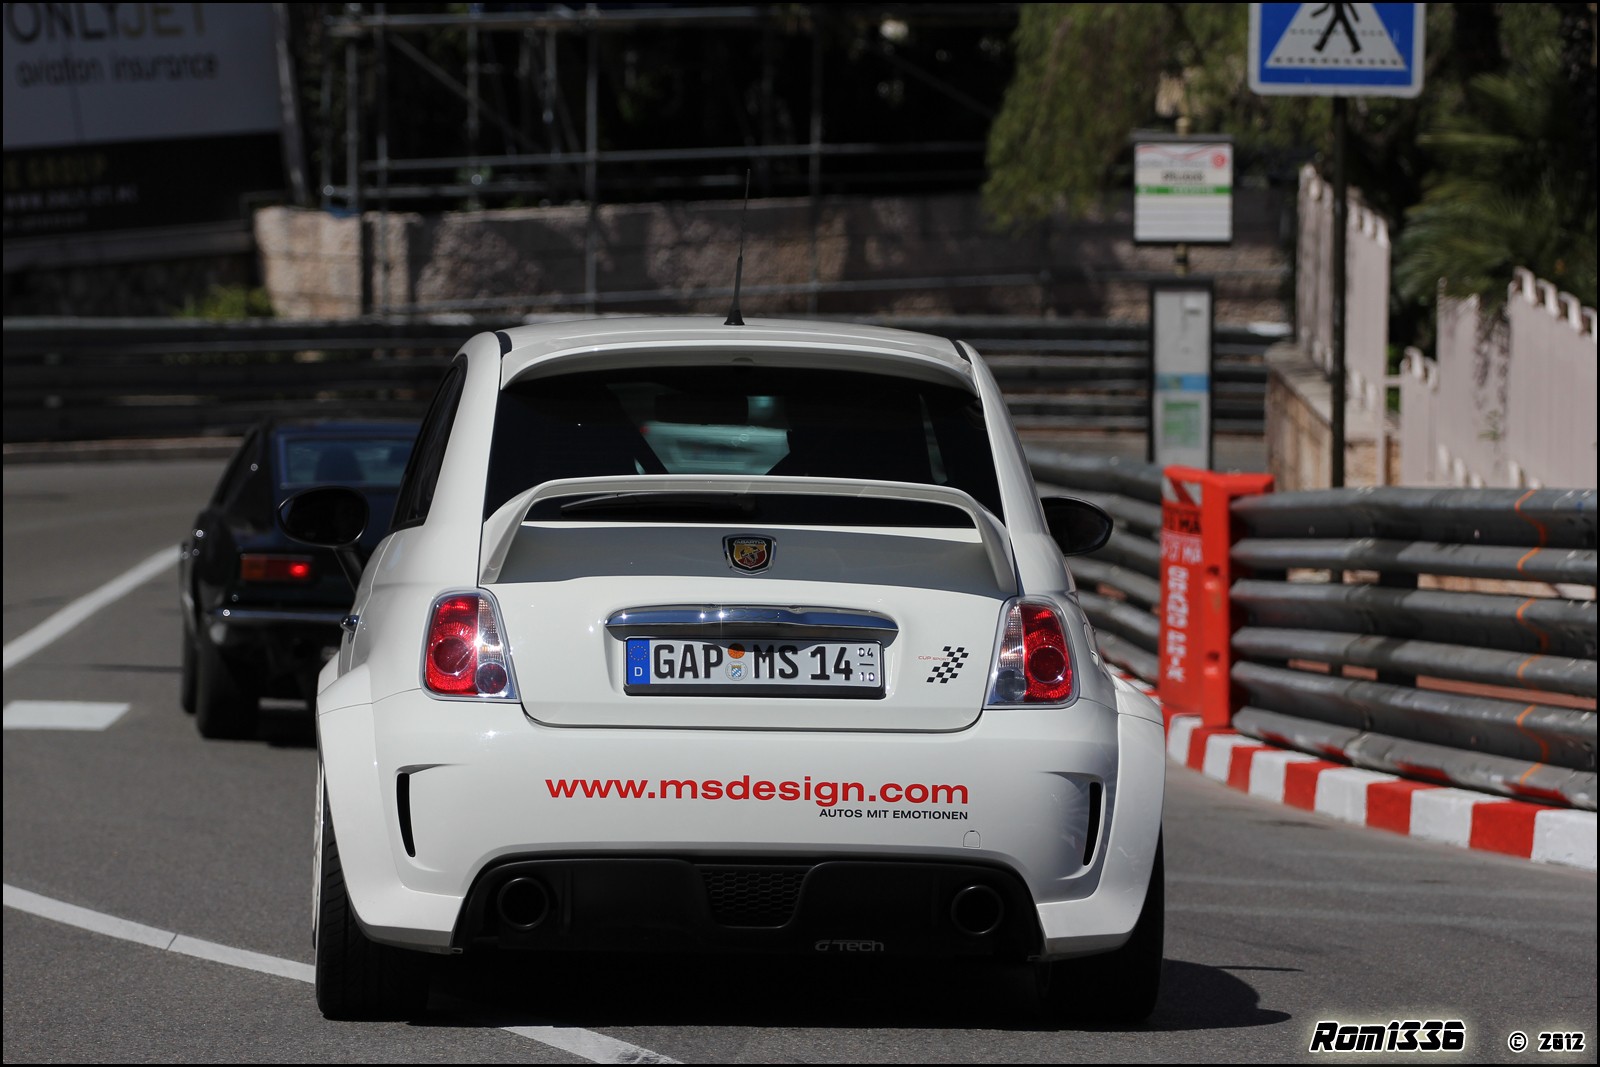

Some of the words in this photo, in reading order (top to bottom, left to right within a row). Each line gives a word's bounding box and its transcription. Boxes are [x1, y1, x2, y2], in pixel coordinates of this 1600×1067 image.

[16, 57, 102, 88] aviation
[110, 51, 219, 81] insurance
[858, 647, 874, 658] 04
[654, 644, 724, 679] GAP
[753, 644, 799, 680] MS
[809, 645, 853, 681] 14
[634, 666, 643, 677] D
[860, 671, 875, 682] 10
[545, 775, 969, 807] www.msdesign.com
[819, 808, 863, 818] AUTOS
[866, 809, 890, 819] MIT
[892, 810, 969, 820] EMOTIONEN
